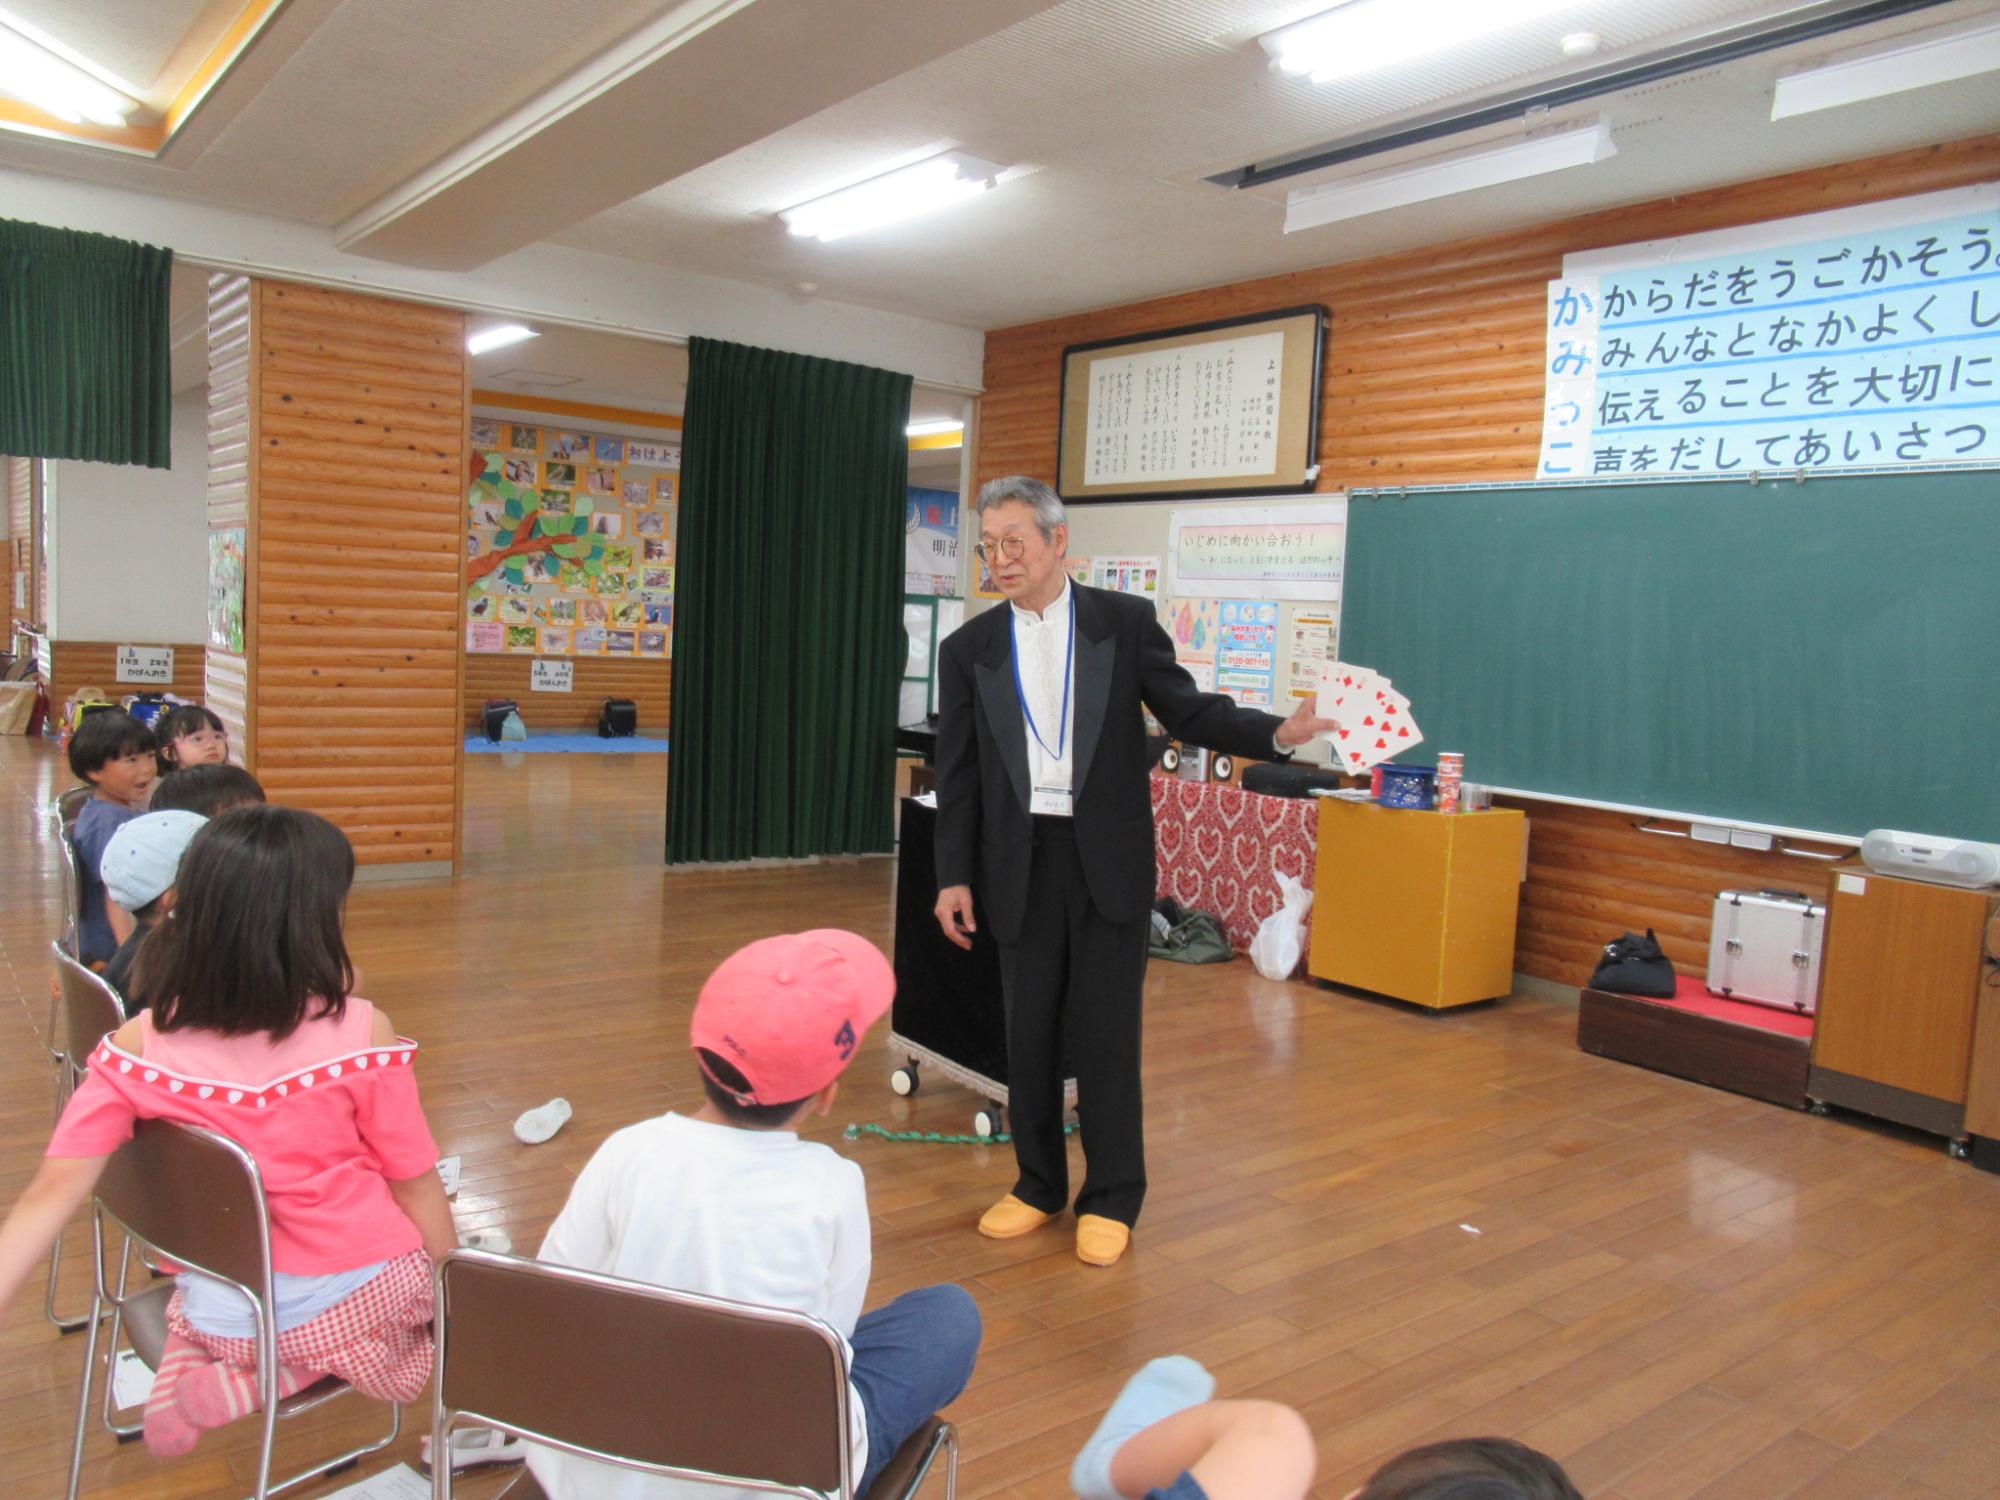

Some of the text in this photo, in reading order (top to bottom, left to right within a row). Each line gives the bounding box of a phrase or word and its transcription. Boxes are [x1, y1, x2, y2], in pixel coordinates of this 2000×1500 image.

[1598, 355, 1993, 426] 伝えることを大切に
[1592, 421, 1987, 475] 声をだしてあいさつ
